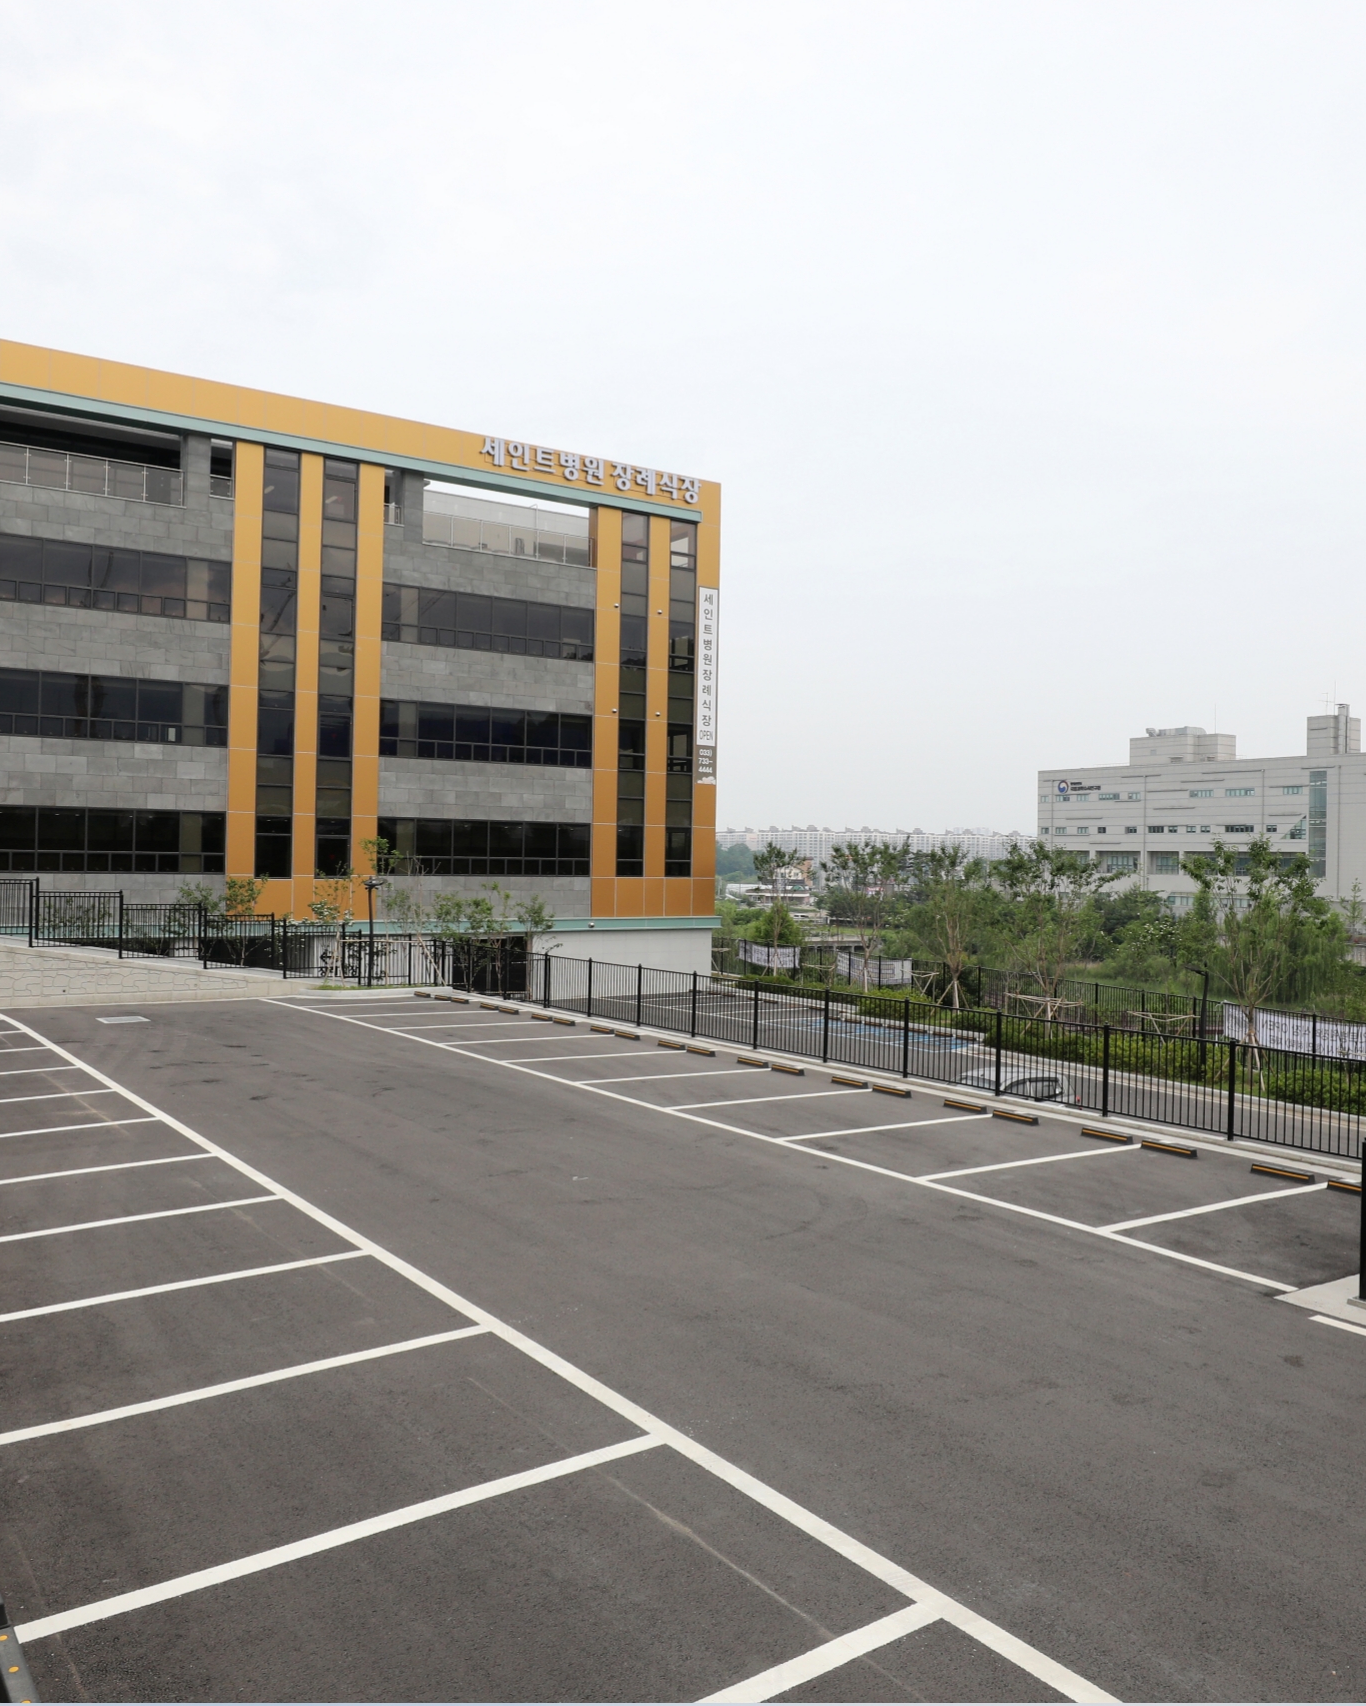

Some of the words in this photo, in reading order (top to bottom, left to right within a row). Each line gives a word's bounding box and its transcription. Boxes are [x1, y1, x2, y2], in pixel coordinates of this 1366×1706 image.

[482, 437, 604, 485] 세인트병원
[612, 462, 701, 504] 장례식장
[702, 594, 714, 726] 세인트병원장례식장
[699, 730, 713, 741] OPEN
